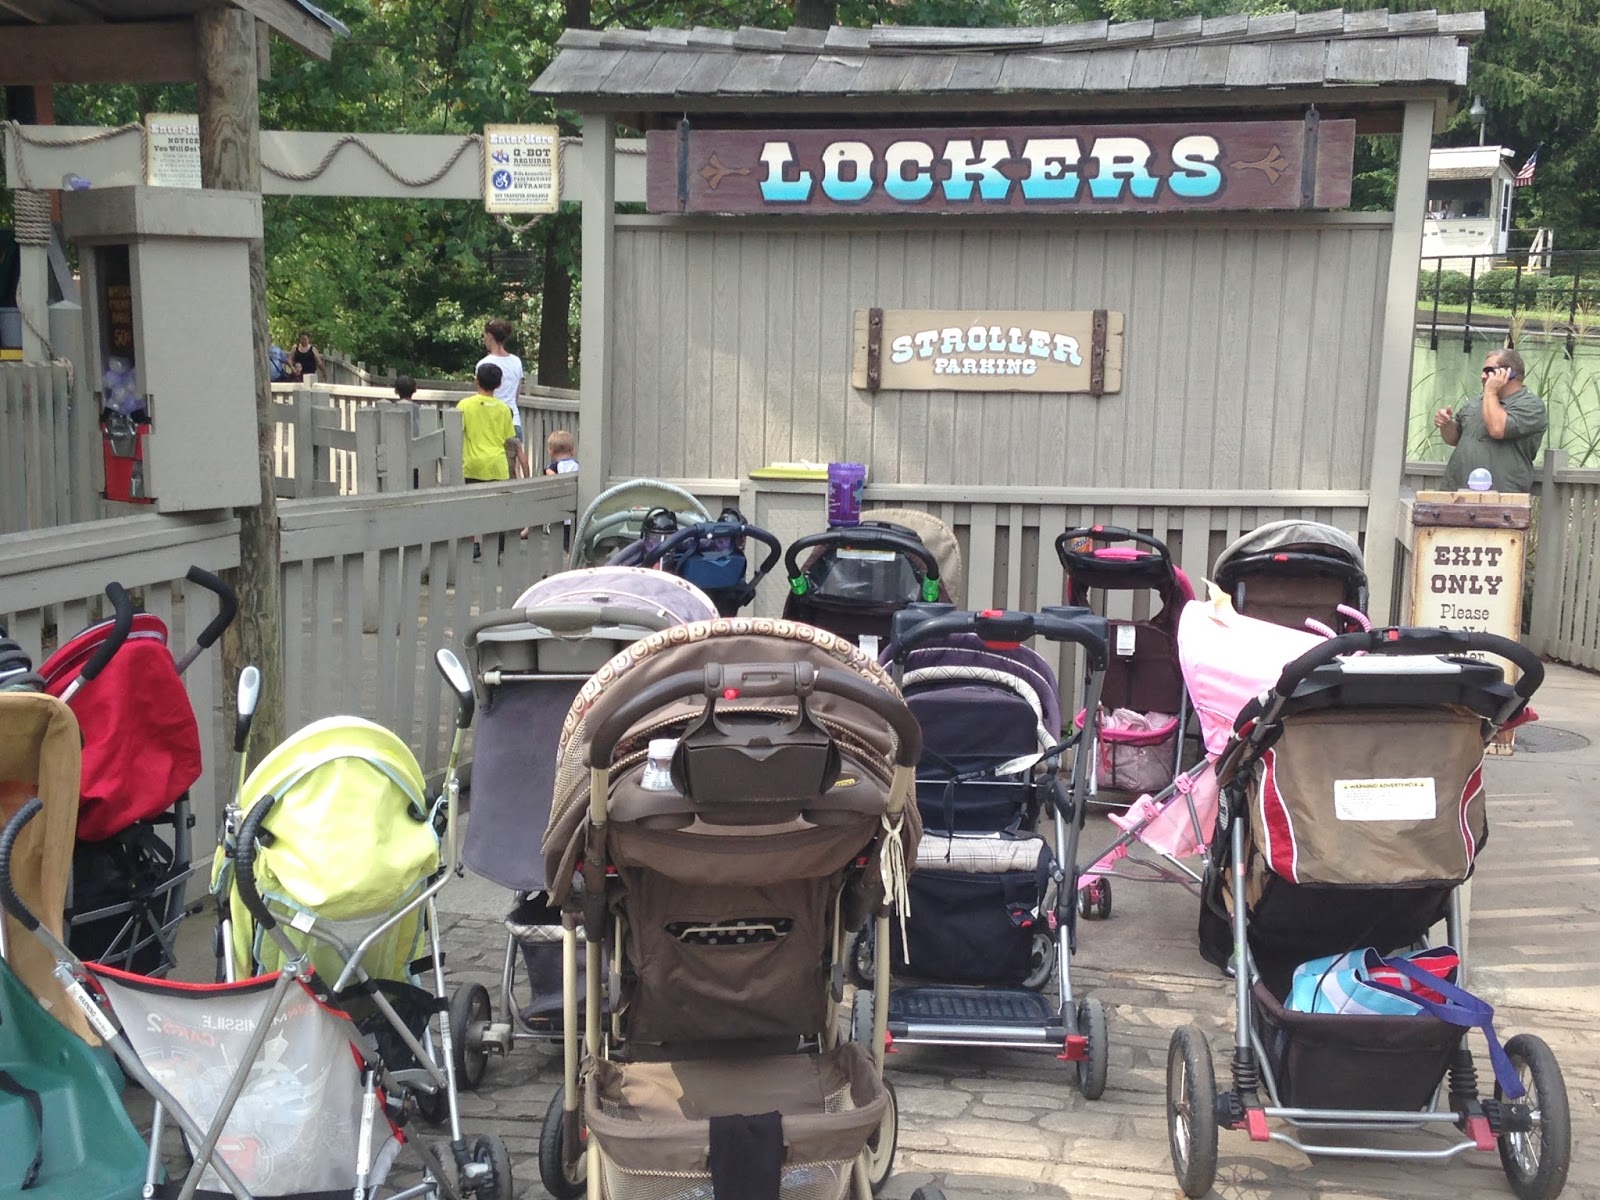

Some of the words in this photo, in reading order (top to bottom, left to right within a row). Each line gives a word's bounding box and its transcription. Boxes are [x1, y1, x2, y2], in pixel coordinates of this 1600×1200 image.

[151, 124, 185, 135] Enter
[490, 133, 523, 145] Enter
[524, 134, 554, 145] Here
[513, 148, 551, 157] Q-BOT
[758, 135, 1223, 202] LOCKERS
[891, 325, 1084, 367] STROLLER
[934, 357, 1038, 376] PARKING
[1434, 545, 1504, 567] EXIT
[1431, 574, 1504, 595] ONLY
[1440, 603, 1490, 620] Please
